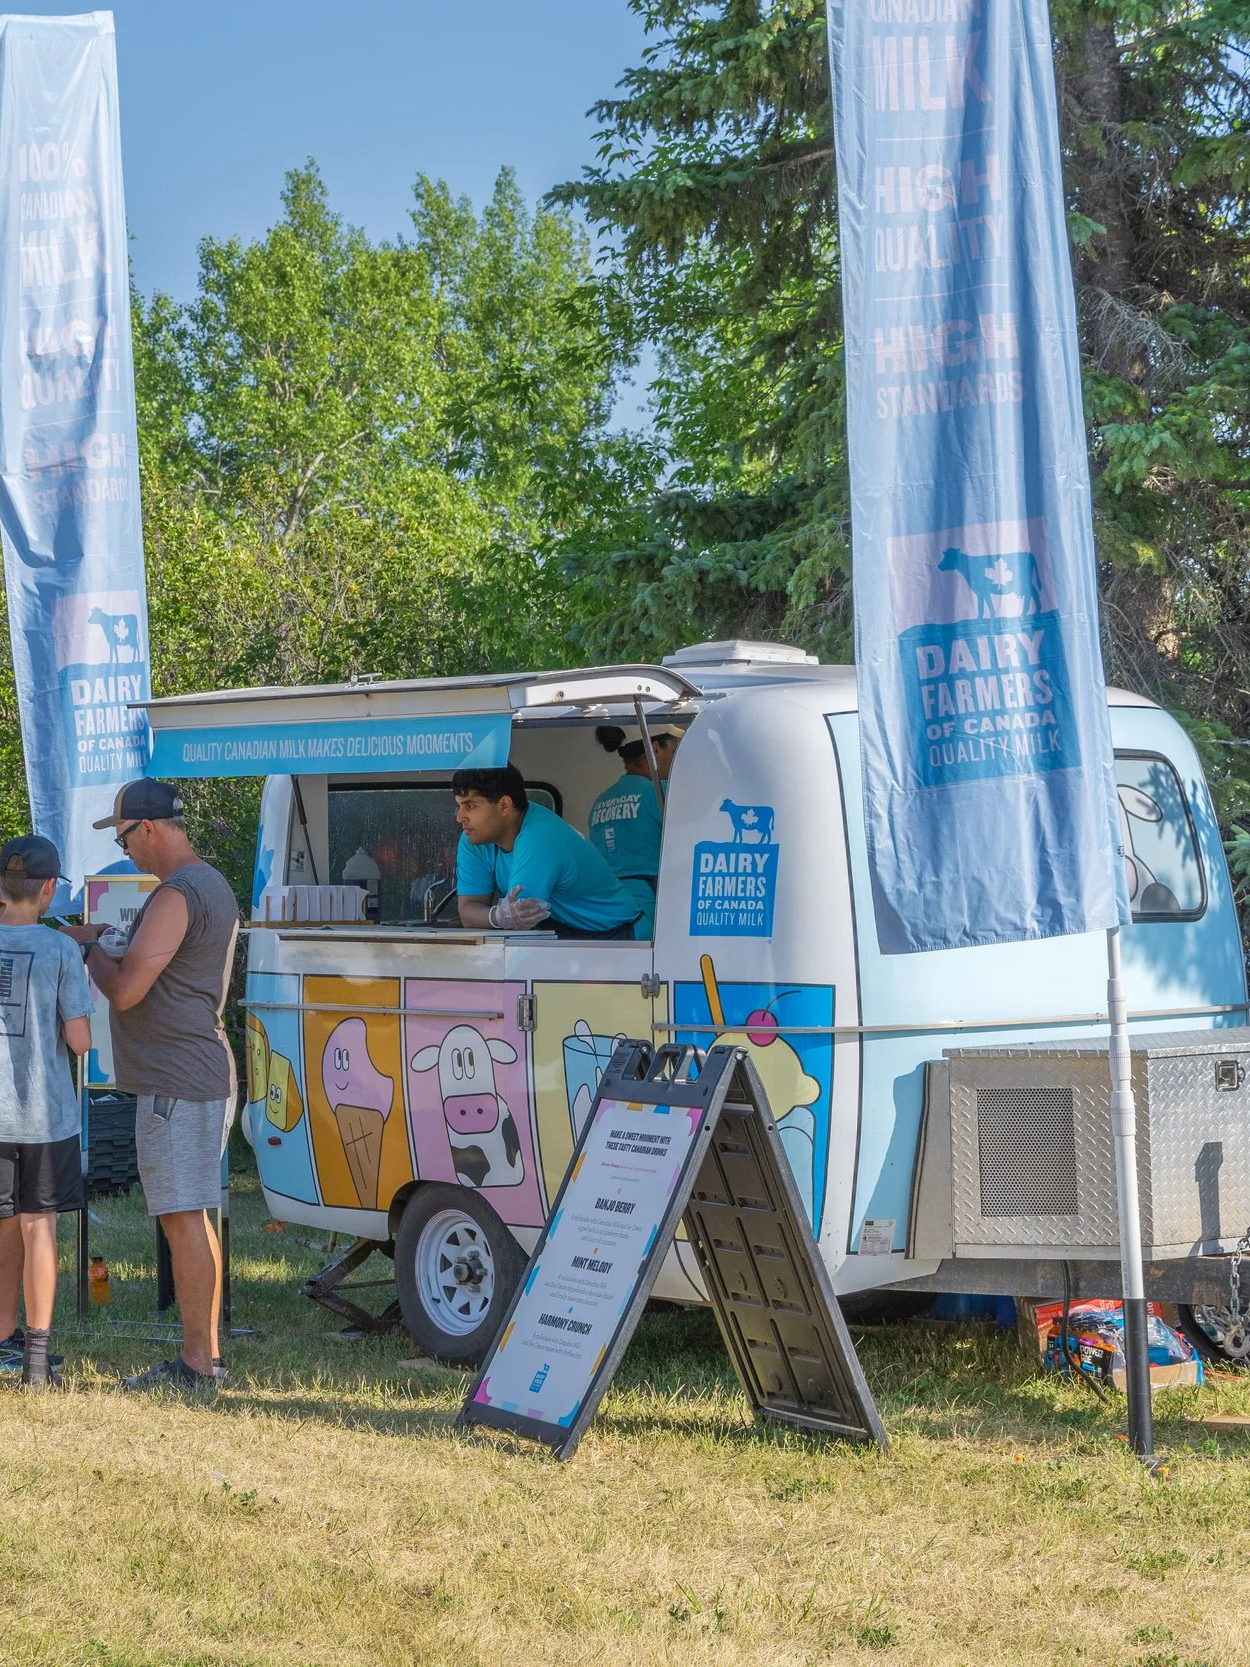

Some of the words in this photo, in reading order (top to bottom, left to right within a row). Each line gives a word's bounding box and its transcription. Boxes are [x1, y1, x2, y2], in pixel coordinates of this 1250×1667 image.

[871, 31, 992, 112] MILK
[18, 140, 88, 183] 100%
[875, 154, 1002, 214] HIGH
[20, 186, 98, 222] CANADIAN
[20, 220, 111, 288] MILK
[874, 214, 1003, 273] QUALITY
[874, 313, 1020, 374] HIGH
[876, 370, 1024, 420] STANDARDS
[916, 629, 1045, 680] DAIRY
[70, 674, 142, 706] DAIRY
[921, 669, 1052, 720] FARMERS
[74, 706, 145, 736] FARMERS
[926, 721, 956, 741] OF
[963, 709, 1057, 735] CANADA
[77, 740, 95, 753] OF
[99, 735, 146, 750] CANADA
[182, 742, 222, 763] QUALITY
[224, 741, 276, 761] CANADIAN
[279, 740, 306, 759] MILK
[307, 738, 344, 758] MAKES
[346, 735, 404, 757] DELICIOUS
[406, 732, 473, 755] MOOMENTS
[929, 735, 1008, 768] QUALITY
[1015, 729, 1062, 756] MILK
[79, 753, 123, 774] QUALITY
[591, 803, 641, 826] RECOVERY
[700, 853, 770, 873] DAIRY
[698, 876, 767, 897] FARMERS
[696, 912, 736, 926] QUALITY
[738, 912, 764, 926] MILK
[697, 900, 712, 910] OF
[715, 900, 764, 910] CANADA
[605, 1141, 619, 1151] THESE
[618, 1142, 631, 1153] TASTY
[630, 1144, 652, 1155] CANADIAN
[650, 1147, 667, 1157] DRINKS
[609, 1129, 623, 1139] MAKE
[625, 1131, 640, 1141] SWEET
[638, 1133, 660, 1144] MOOMENT
[659, 1135, 671, 1145] WITH
[594, 1198, 616, 1211] BANJO
[614, 1201, 636, 1215] BERRY
[571, 1256, 589, 1270] MINT
[586, 1259, 613, 1274] MELODY
[538, 1313, 569, 1330] HARMONY
[567, 1320, 592, 1335] CRUNCH
